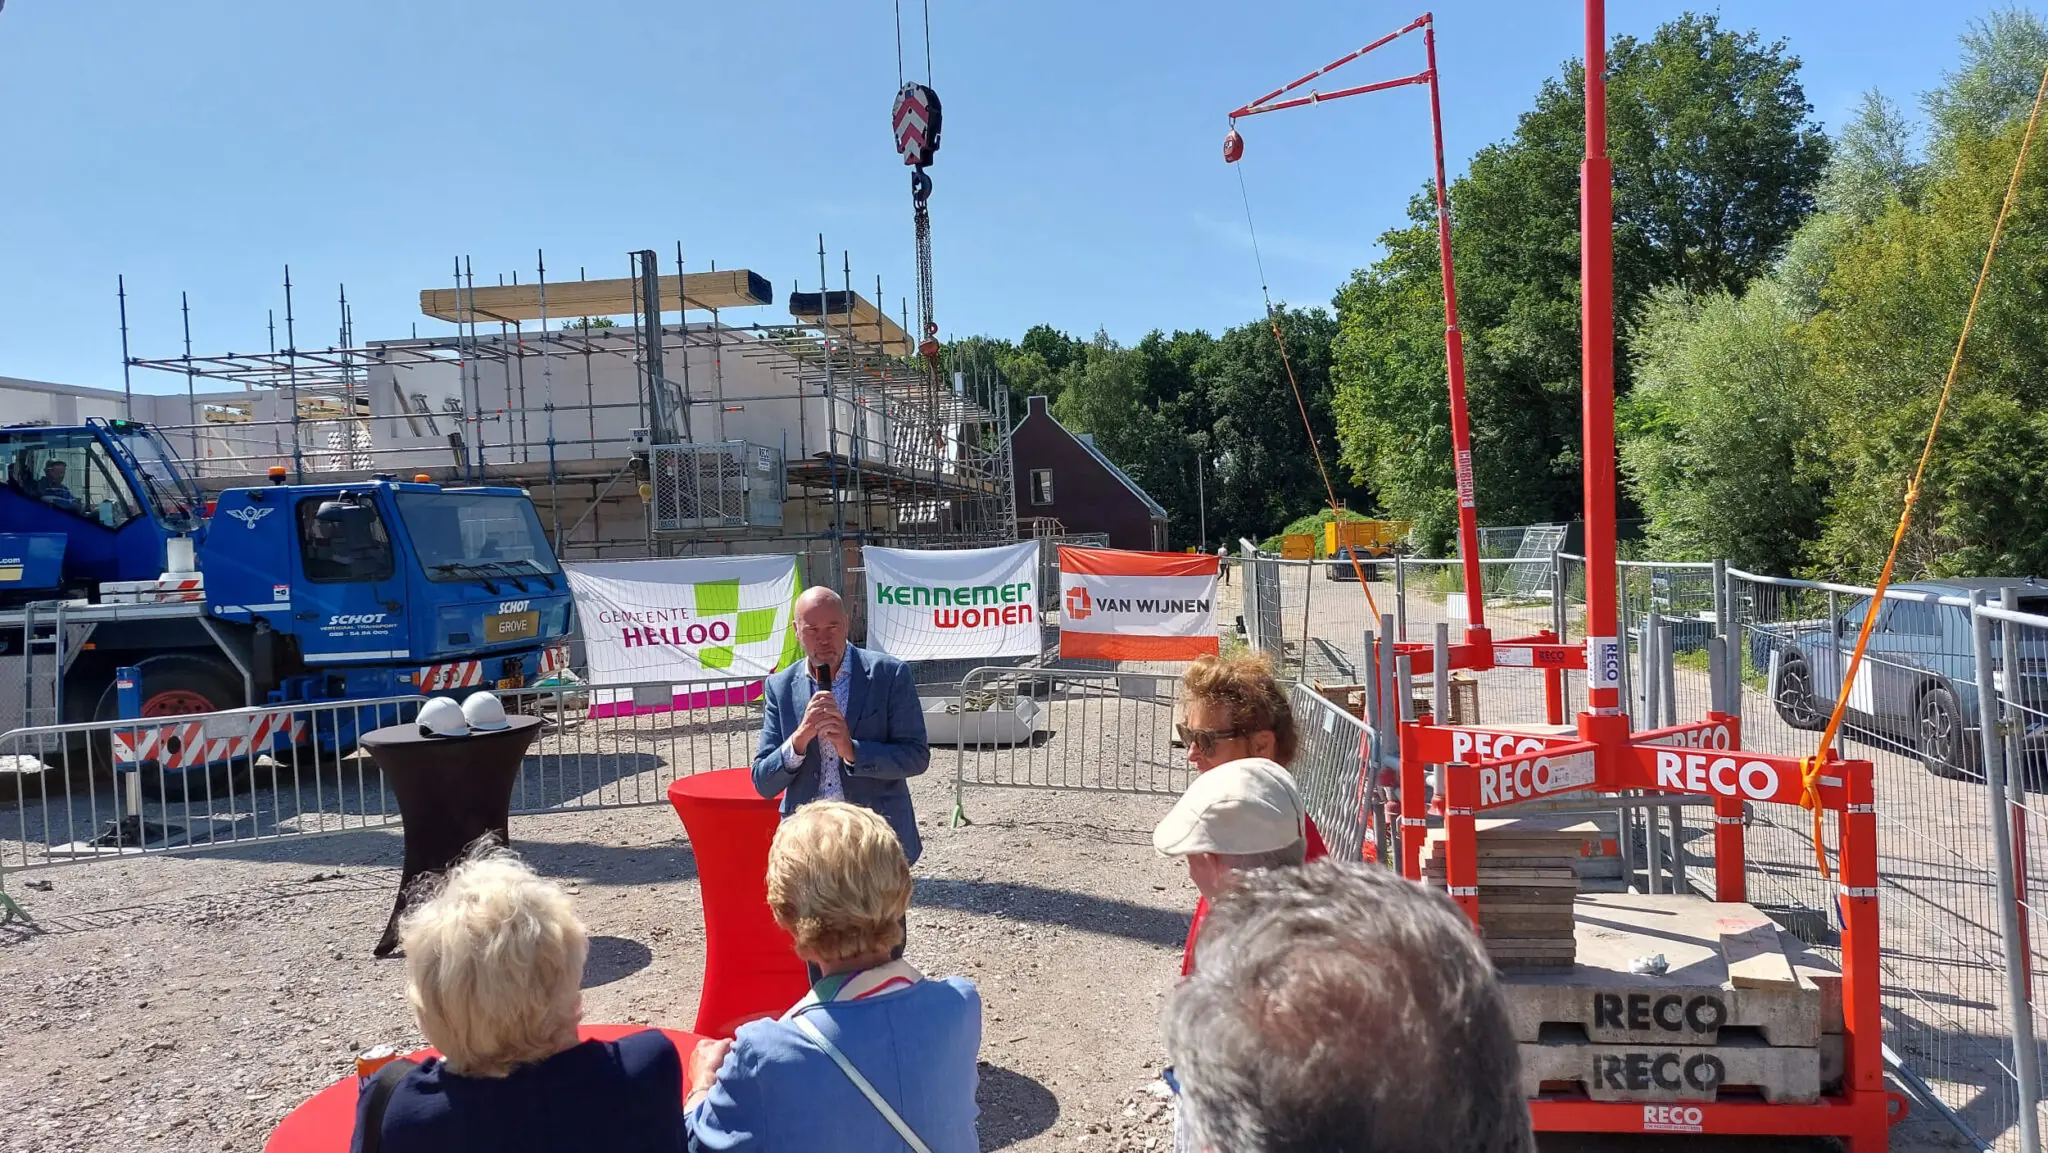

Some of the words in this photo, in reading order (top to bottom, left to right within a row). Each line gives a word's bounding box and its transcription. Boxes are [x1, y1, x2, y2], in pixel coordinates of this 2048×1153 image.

[877, 582, 1031, 607] KENNEMER
[1096, 598, 1131, 613] VAN
[1136, 599, 1210, 613] WIJNEN
[328, 613, 387, 625] SCHOT
[498, 600, 530, 615] SCHOT
[599, 607, 690, 624] GEMEENTE
[934, 604, 1033, 629] WONEN
[498, 619, 529, 633] GROVE
[622, 621, 730, 648] HEILOO
[1538, 650, 1565, 660] RECO
[1606, 643, 1618, 681] RECO
[1480, 756, 1551, 806] RECO
[1656, 751, 1779, 800] RECO
[1594, 993, 1728, 1034] RECO
[1592, 1052, 1726, 1092] RECO
[1643, 1106, 1703, 1125] RECO
